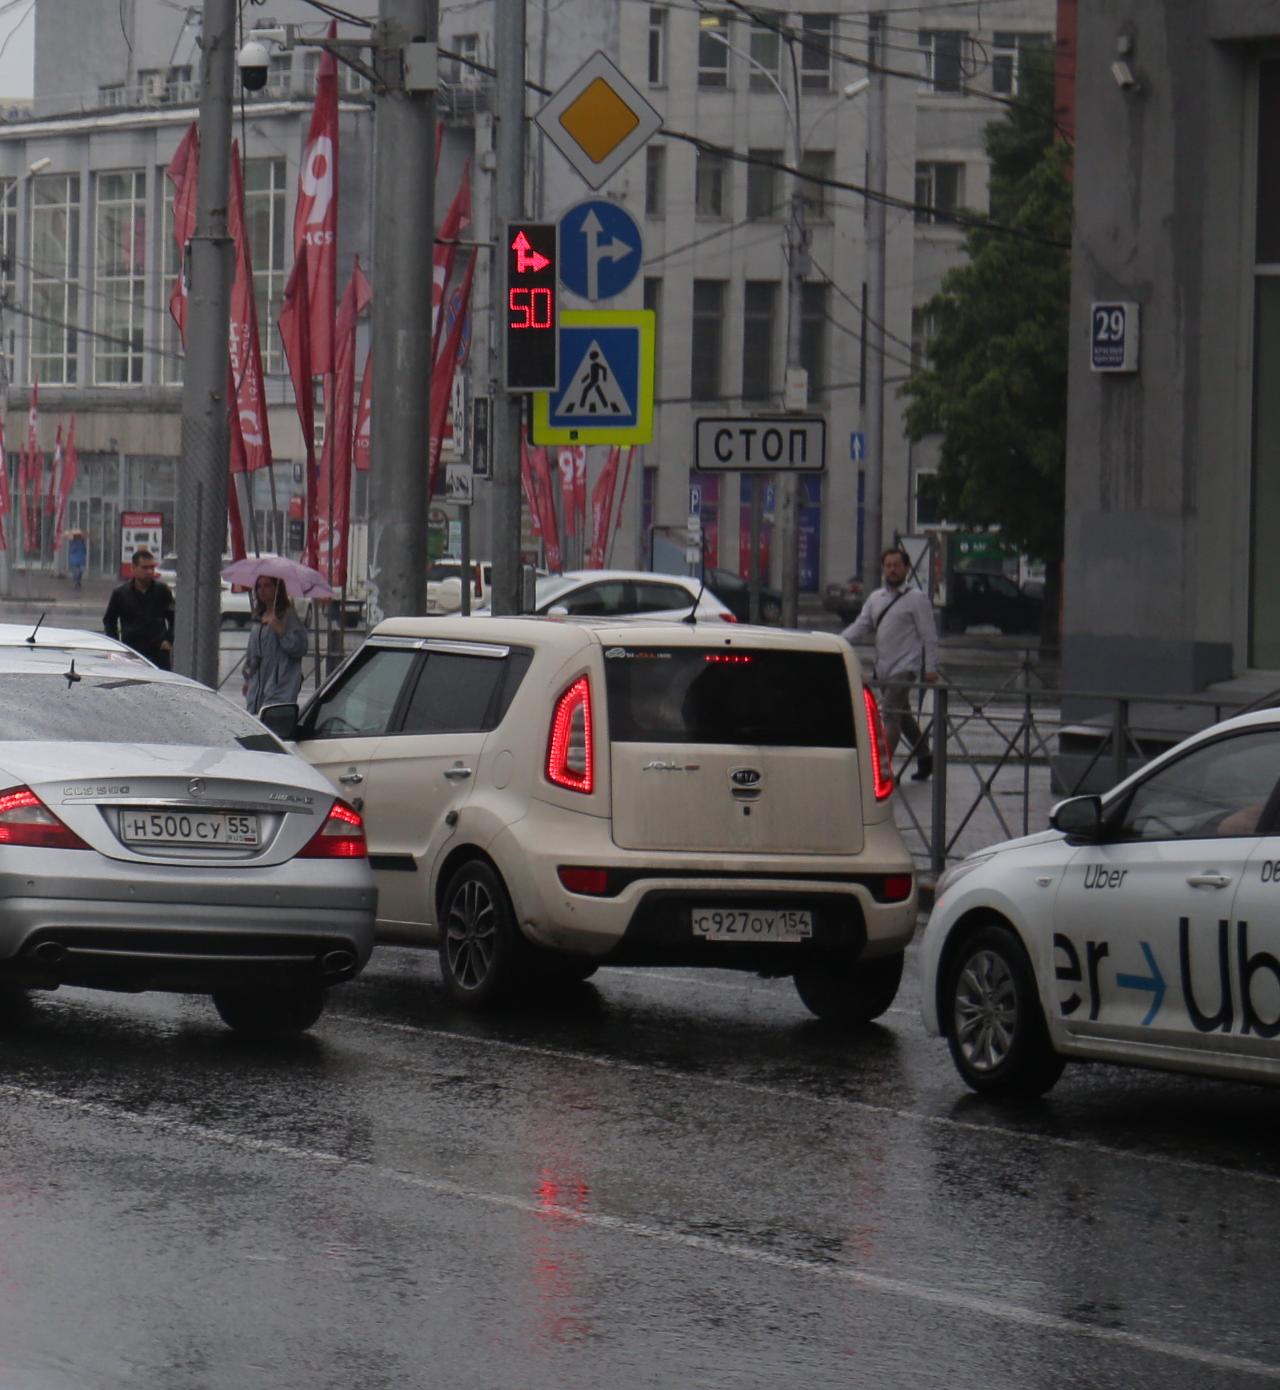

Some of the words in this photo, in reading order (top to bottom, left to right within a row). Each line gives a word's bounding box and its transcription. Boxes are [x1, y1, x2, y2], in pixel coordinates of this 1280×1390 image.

[509, 287, 551, 329] 50
[1096, 310, 1124, 341] 29
[714, 428, 807, 463] СТОП
[133, 815, 221, 840] Н500СУ
[228, 816, 250, 834] 55
[1083, 863, 1128, 889] Uber
[778, 911, 810, 929] 154
